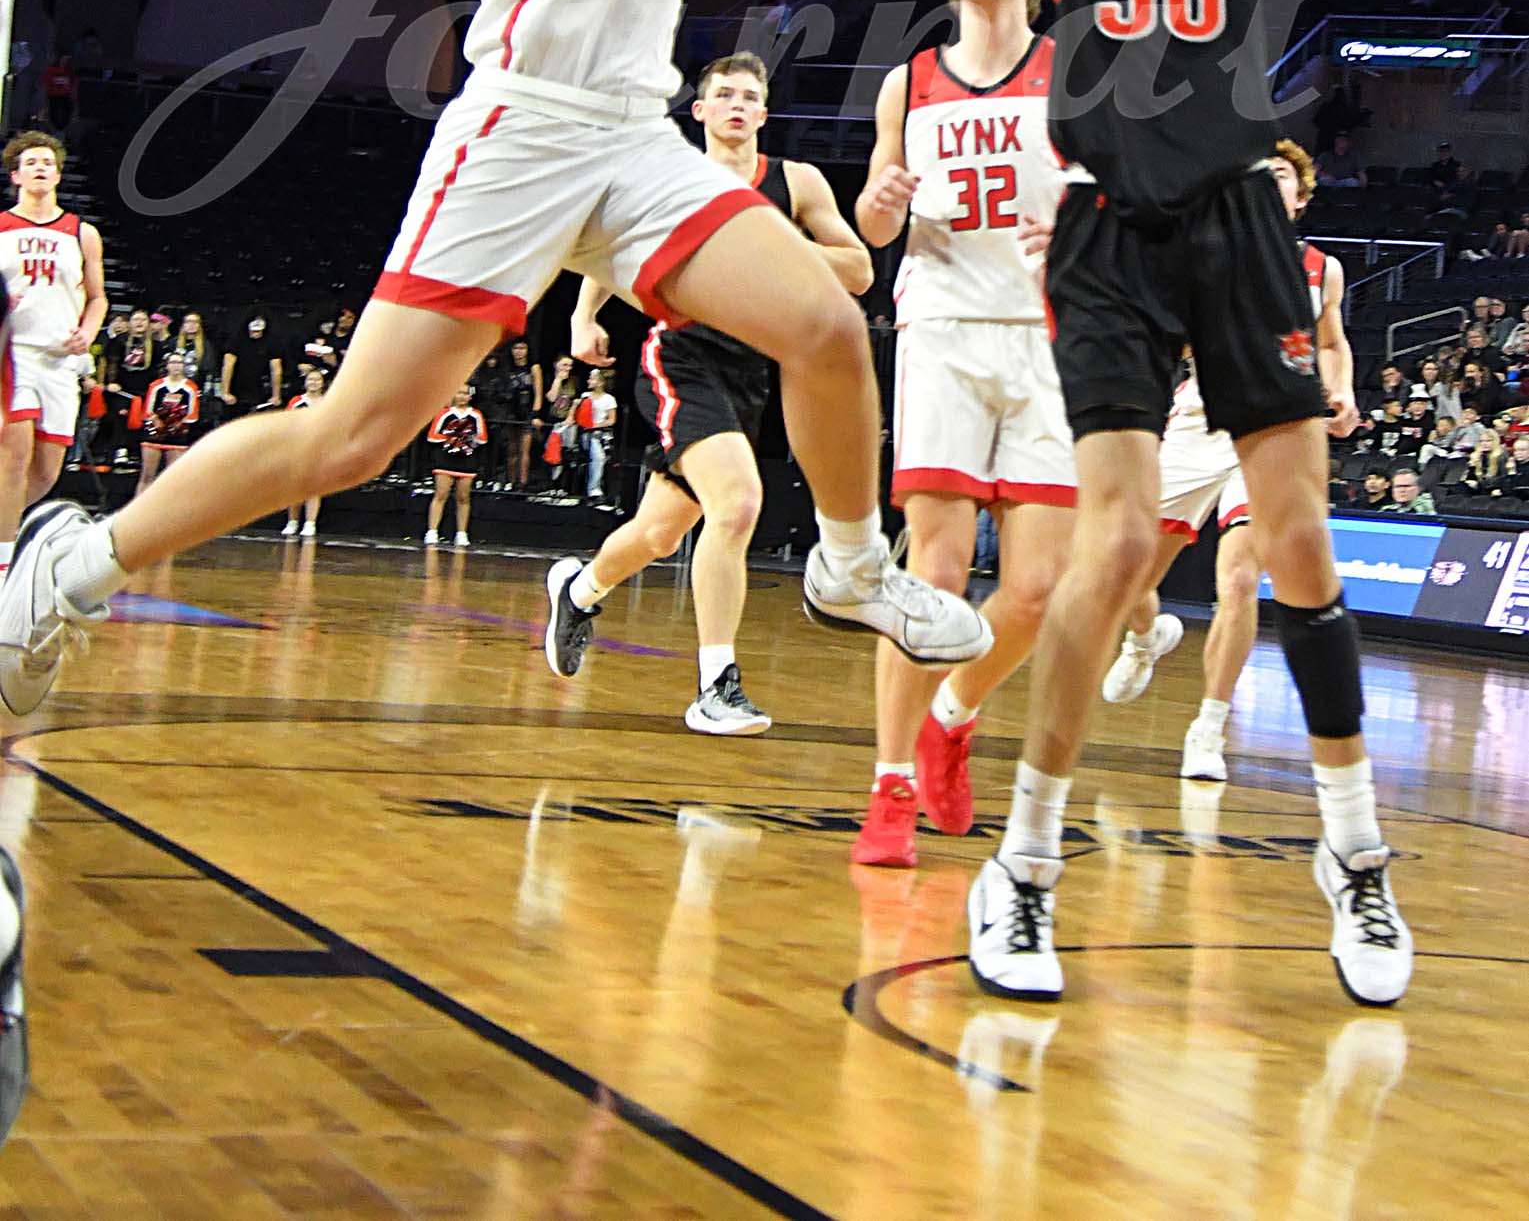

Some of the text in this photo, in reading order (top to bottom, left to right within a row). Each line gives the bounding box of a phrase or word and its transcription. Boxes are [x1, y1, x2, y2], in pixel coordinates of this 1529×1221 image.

[937, 115, 1023, 160] LYNX
[948, 164, 1019, 233] 32
[18, 237, 59, 255] LYNX
[22, 259, 55, 286] 44
